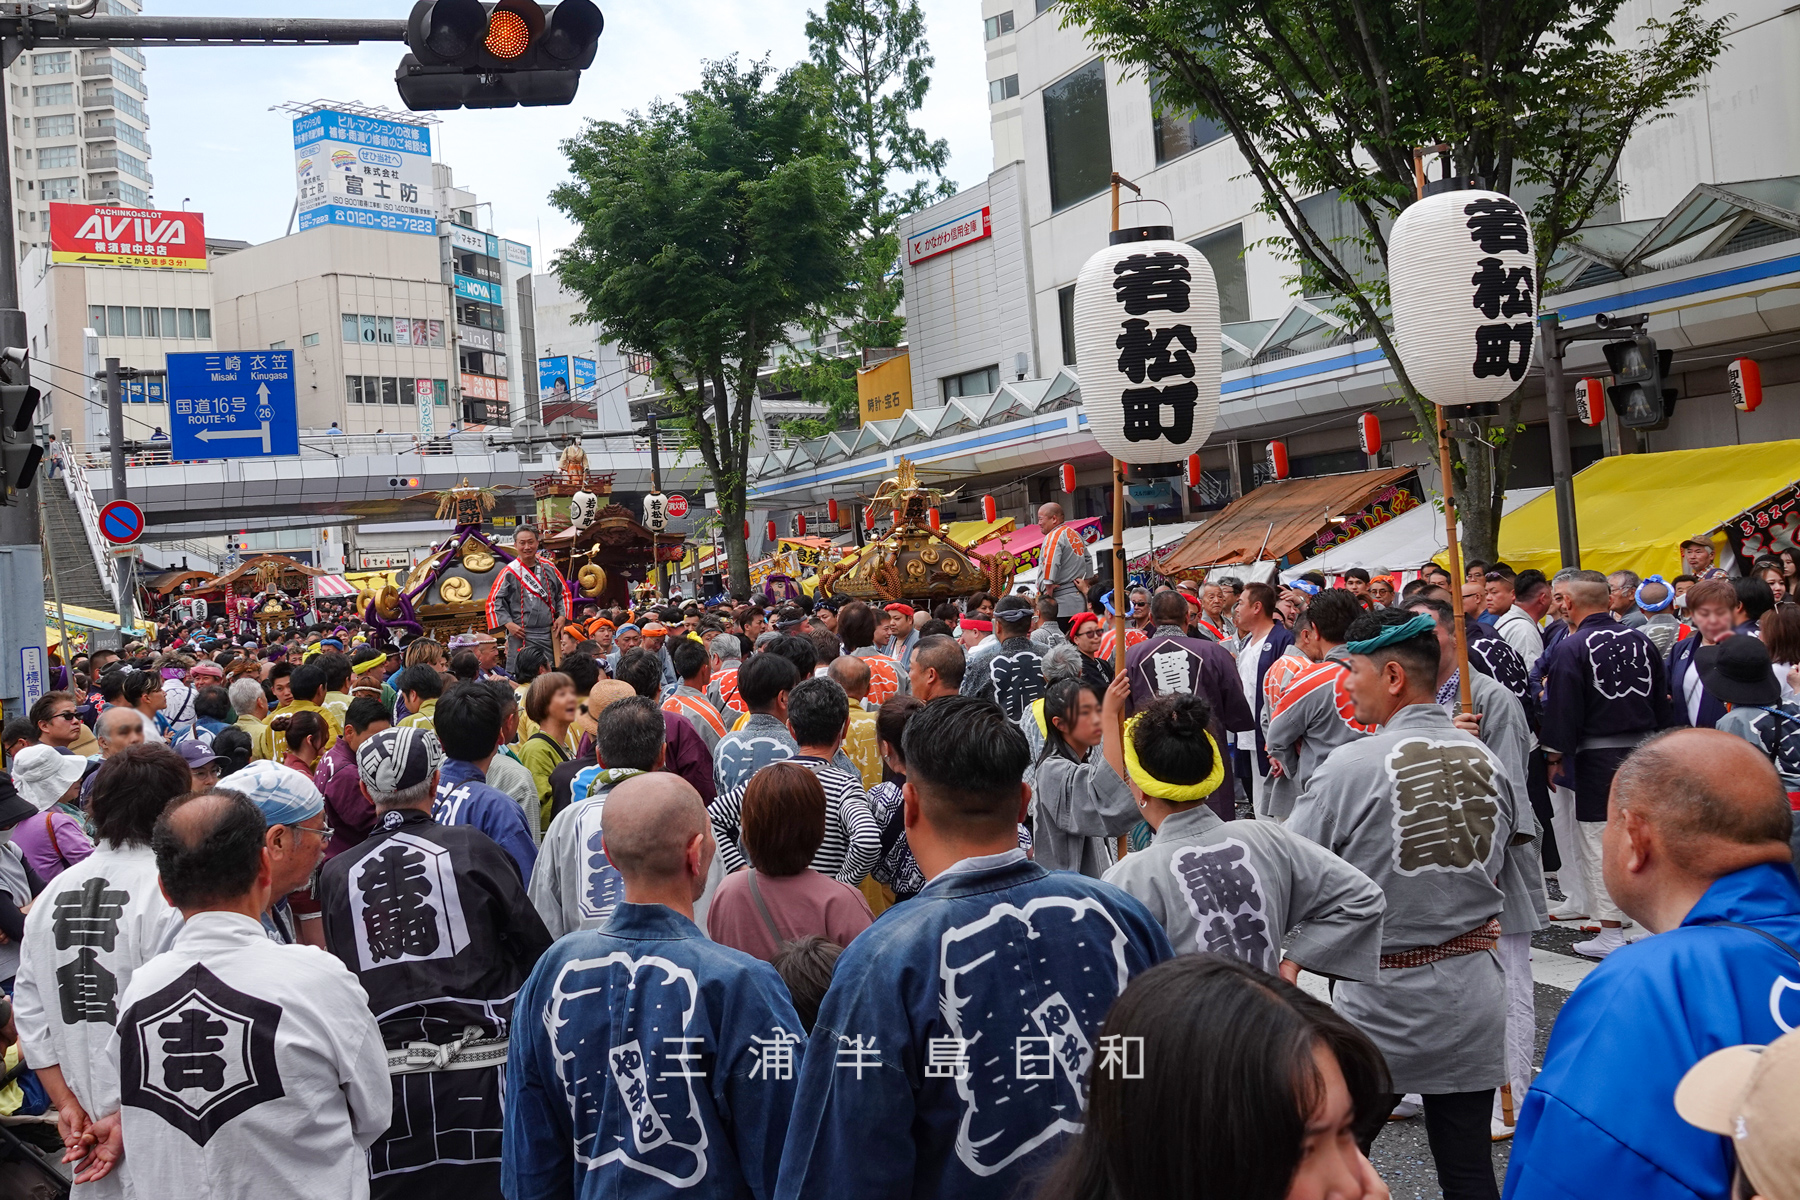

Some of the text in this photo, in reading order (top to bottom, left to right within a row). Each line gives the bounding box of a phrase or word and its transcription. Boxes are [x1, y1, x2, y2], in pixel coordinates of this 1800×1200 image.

[361, 151, 400, 164] ぜひ当社へ
[363, 166, 399, 180] 株式会社
[301, 181, 325, 200] 富士防
[345, 174, 418, 204] 富士防
[94, 208, 162, 219] PACHINKO&SLOT
[346, 210, 432, 233] 0120-32-7223
[74, 214, 186, 245] AVIVA
[924, 219, 978, 251] かながわ信用金庫
[95, 241, 167, 256] 横須賀中央店
[461, 233, 482, 248] マキチエ
[466, 281, 490, 299] NOVA
[1464, 197, 1534, 383] 若松町
[460, 329, 490, 346] Link
[1112, 251, 1199, 445] 若松町
[205, 354, 288, 372] 三崎 衣笠
[211, 371, 288, 382] Misaki Kinugasa
[176, 396, 247, 415] 国道16号
[867, 391, 900, 413] 時計・宝石
[188, 414, 237, 425] ROUTE-16
[258, 407, 271, 418] 26
[583, 498, 597, 527] 若松町
[650, 499, 664, 528] 若松町
[668, 501, 686, 511] 消火栓
[1388, 738, 1500, 874] 諏訪
[158, 1008, 230, 1093] 吉
